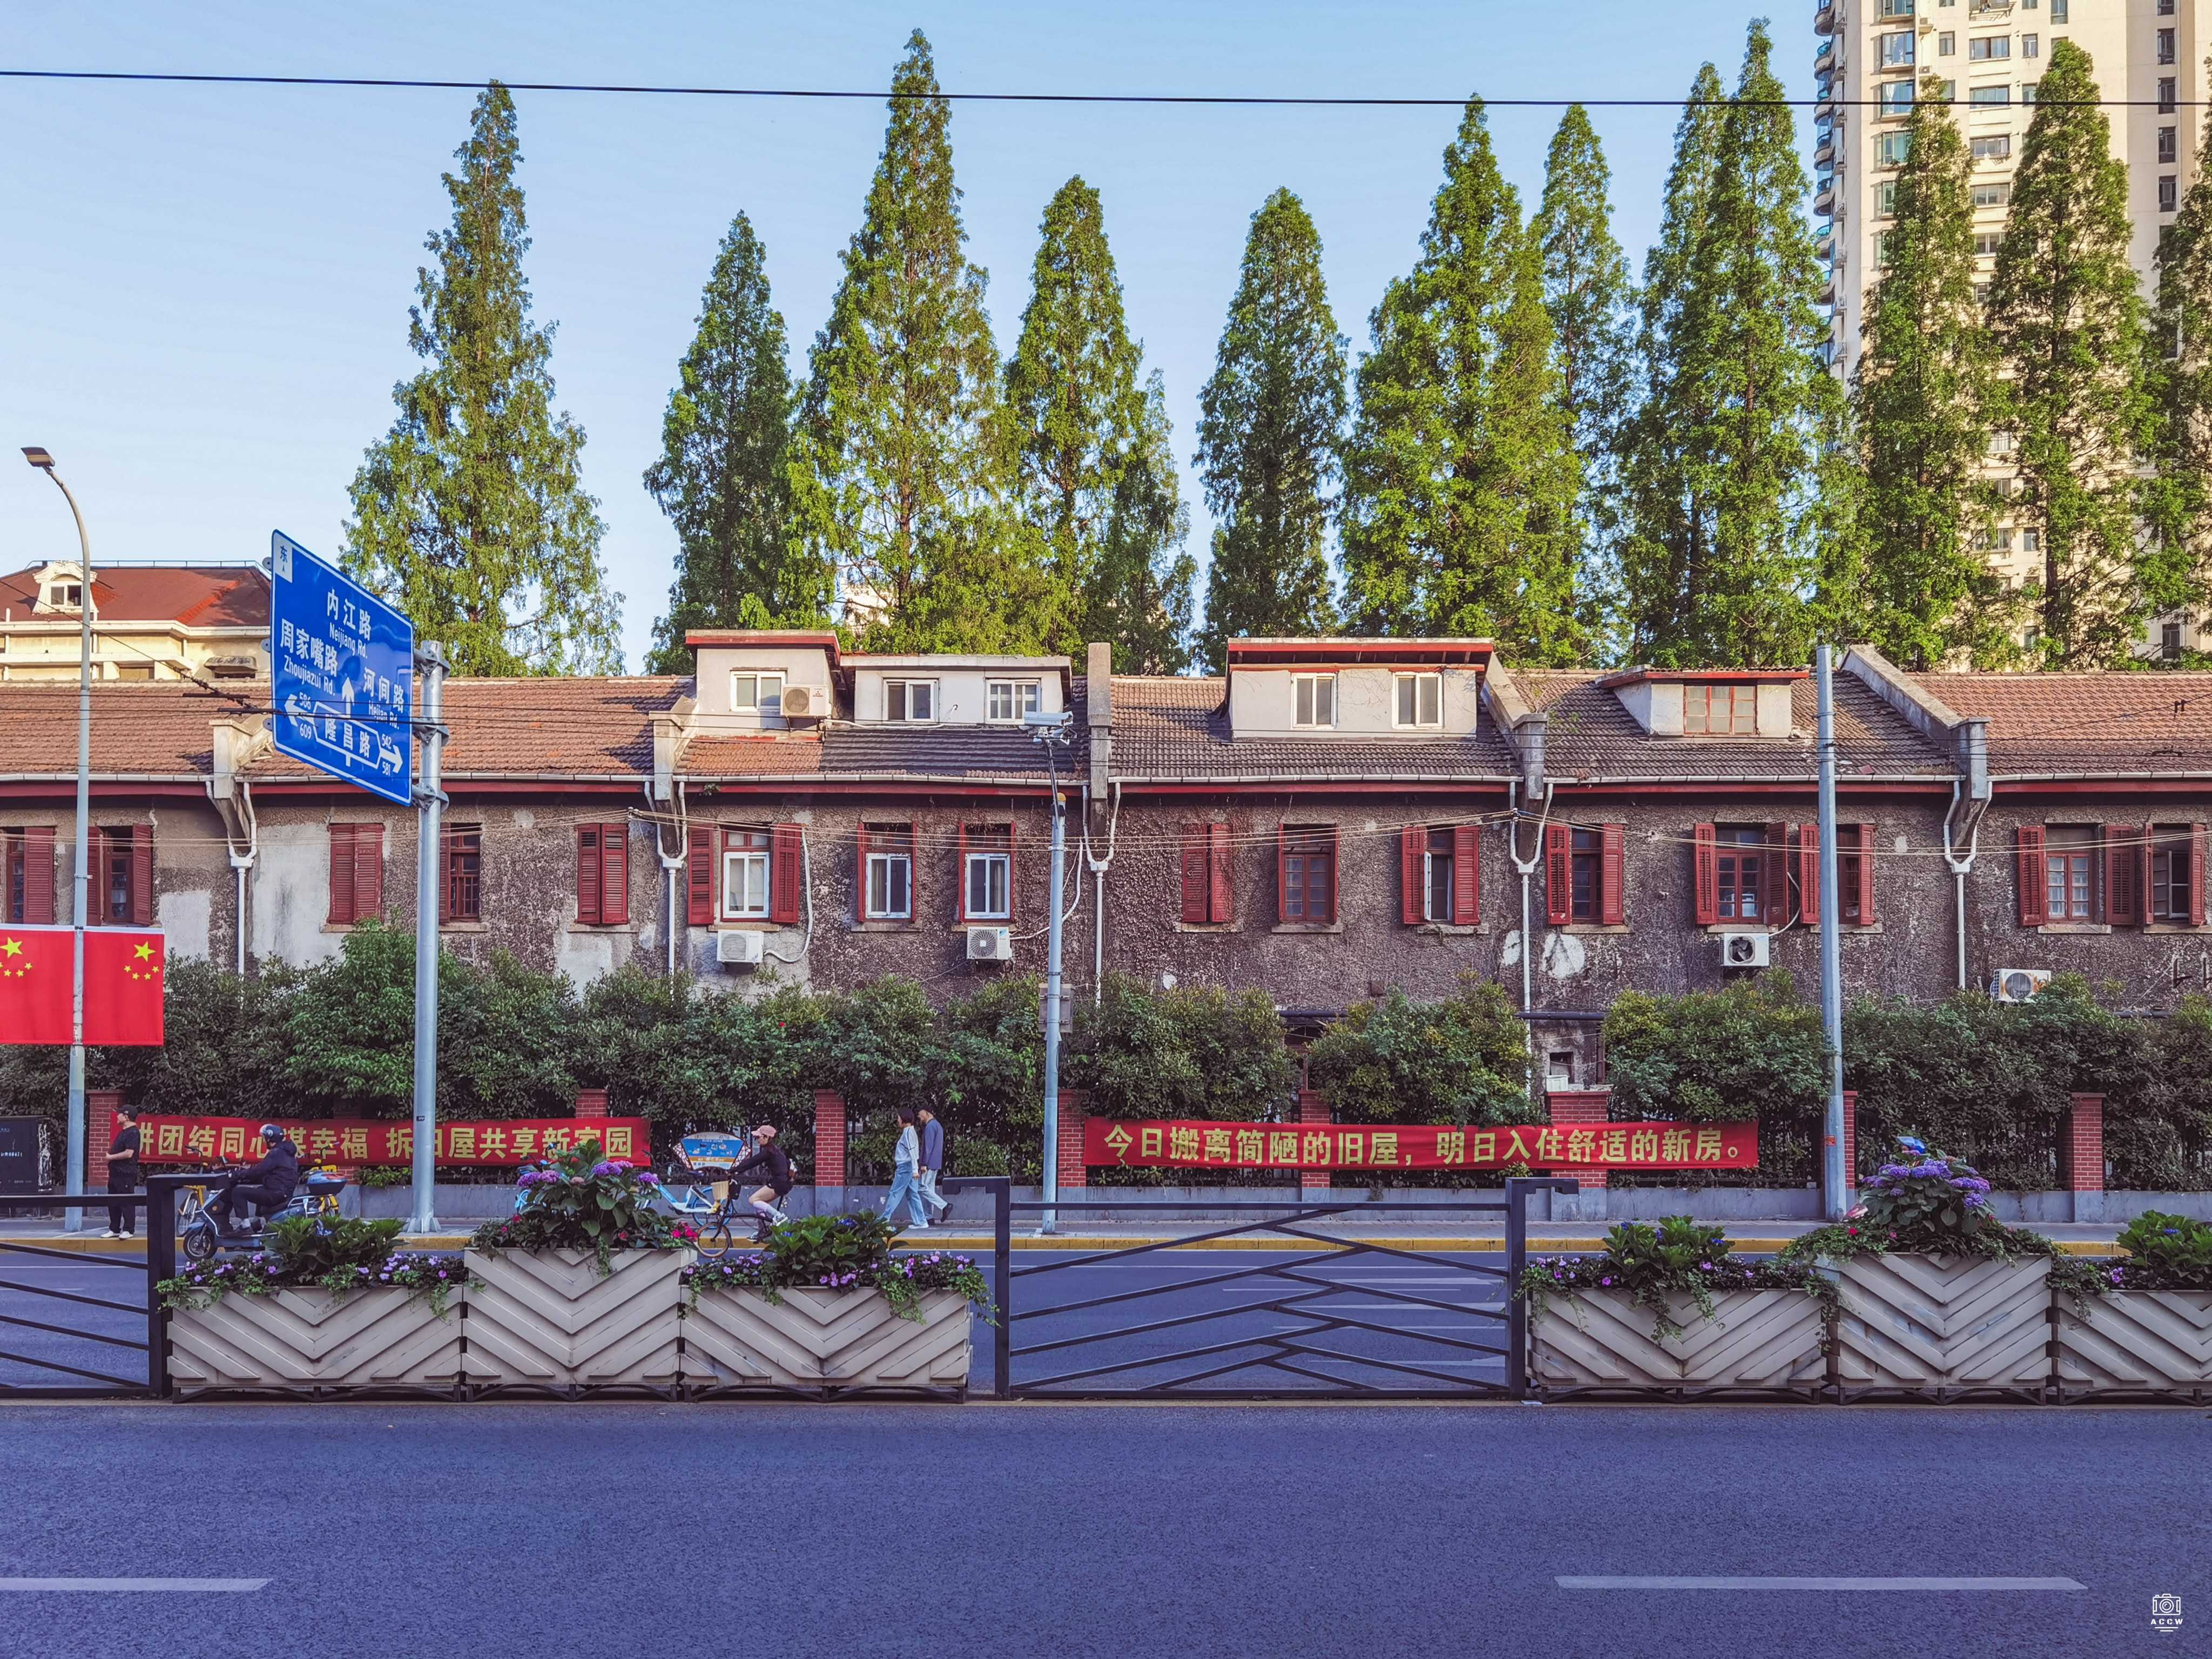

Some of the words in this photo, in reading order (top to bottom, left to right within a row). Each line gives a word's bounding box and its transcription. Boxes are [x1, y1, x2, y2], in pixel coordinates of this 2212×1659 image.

[280, 545, 288, 563] 东
[327, 587, 372, 642] 内江路
[280, 618, 338, 678] 周家嘴路
[329, 623, 356, 656] Neijiang
[358, 639, 368, 659] Rd.
[284, 654, 321, 689] Zhoujiazui
[323, 675, 335, 696] Rd.
[363, 667, 404, 714] 河间路
[299, 692, 312, 710] 586
[368, 700, 388, 723] Hejian
[389, 711, 400, 730] Rd.
[299, 723, 312, 740] 609
[325, 713, 371, 759] 隆昌路
[381, 733, 392, 750] 542
[382, 760, 392, 777] 581
